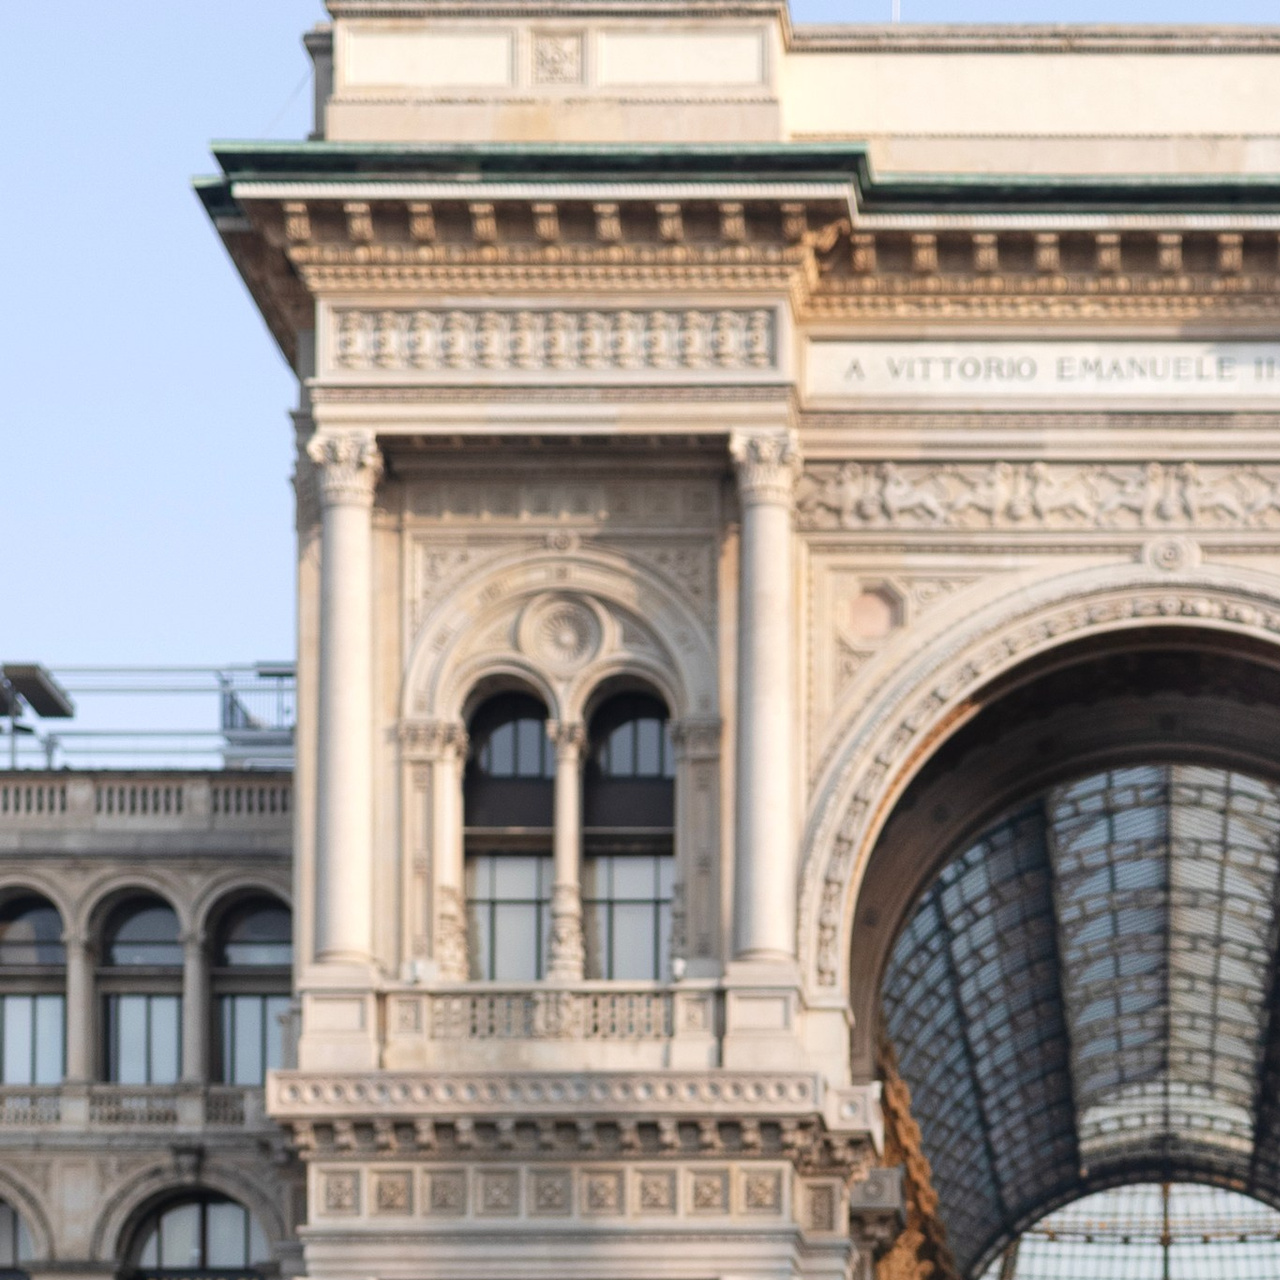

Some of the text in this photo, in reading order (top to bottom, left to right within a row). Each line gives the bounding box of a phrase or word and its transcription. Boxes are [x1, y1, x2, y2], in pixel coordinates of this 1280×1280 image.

[844, 356, 865, 381] A
[886, 356, 1038, 382] VITTORIO
[1056, 356, 1236, 382] EMANUELE
